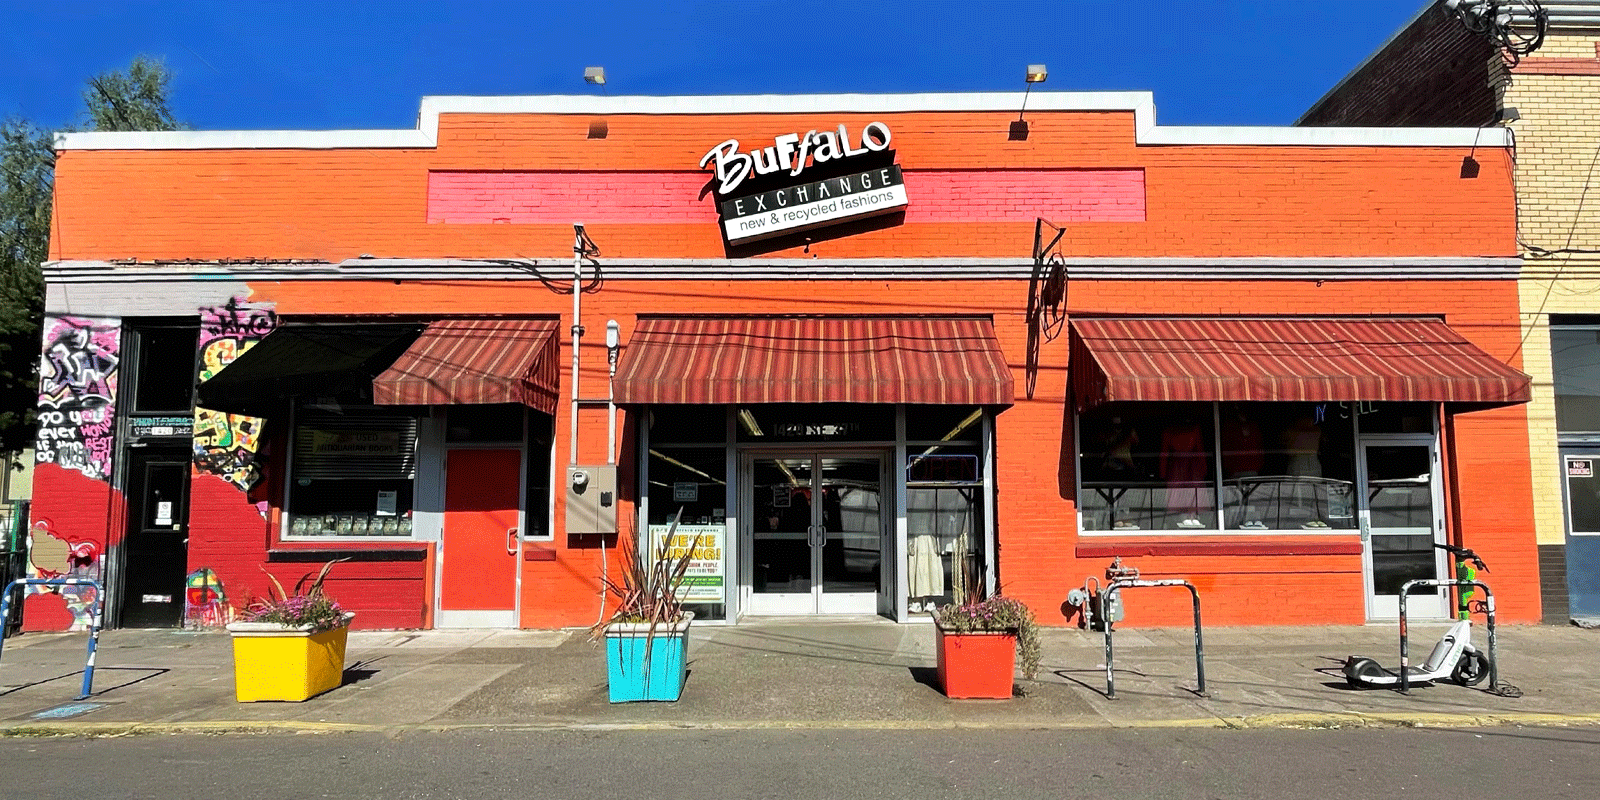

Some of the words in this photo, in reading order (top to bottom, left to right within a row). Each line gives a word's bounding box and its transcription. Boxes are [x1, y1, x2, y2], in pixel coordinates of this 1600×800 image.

[734, 169, 892, 216] EXCHANGE
[739, 216, 766, 231] new
[770, 212, 780, 225] &
[783, 200, 837, 223] recycled
[839, 190, 895, 210] fashions
